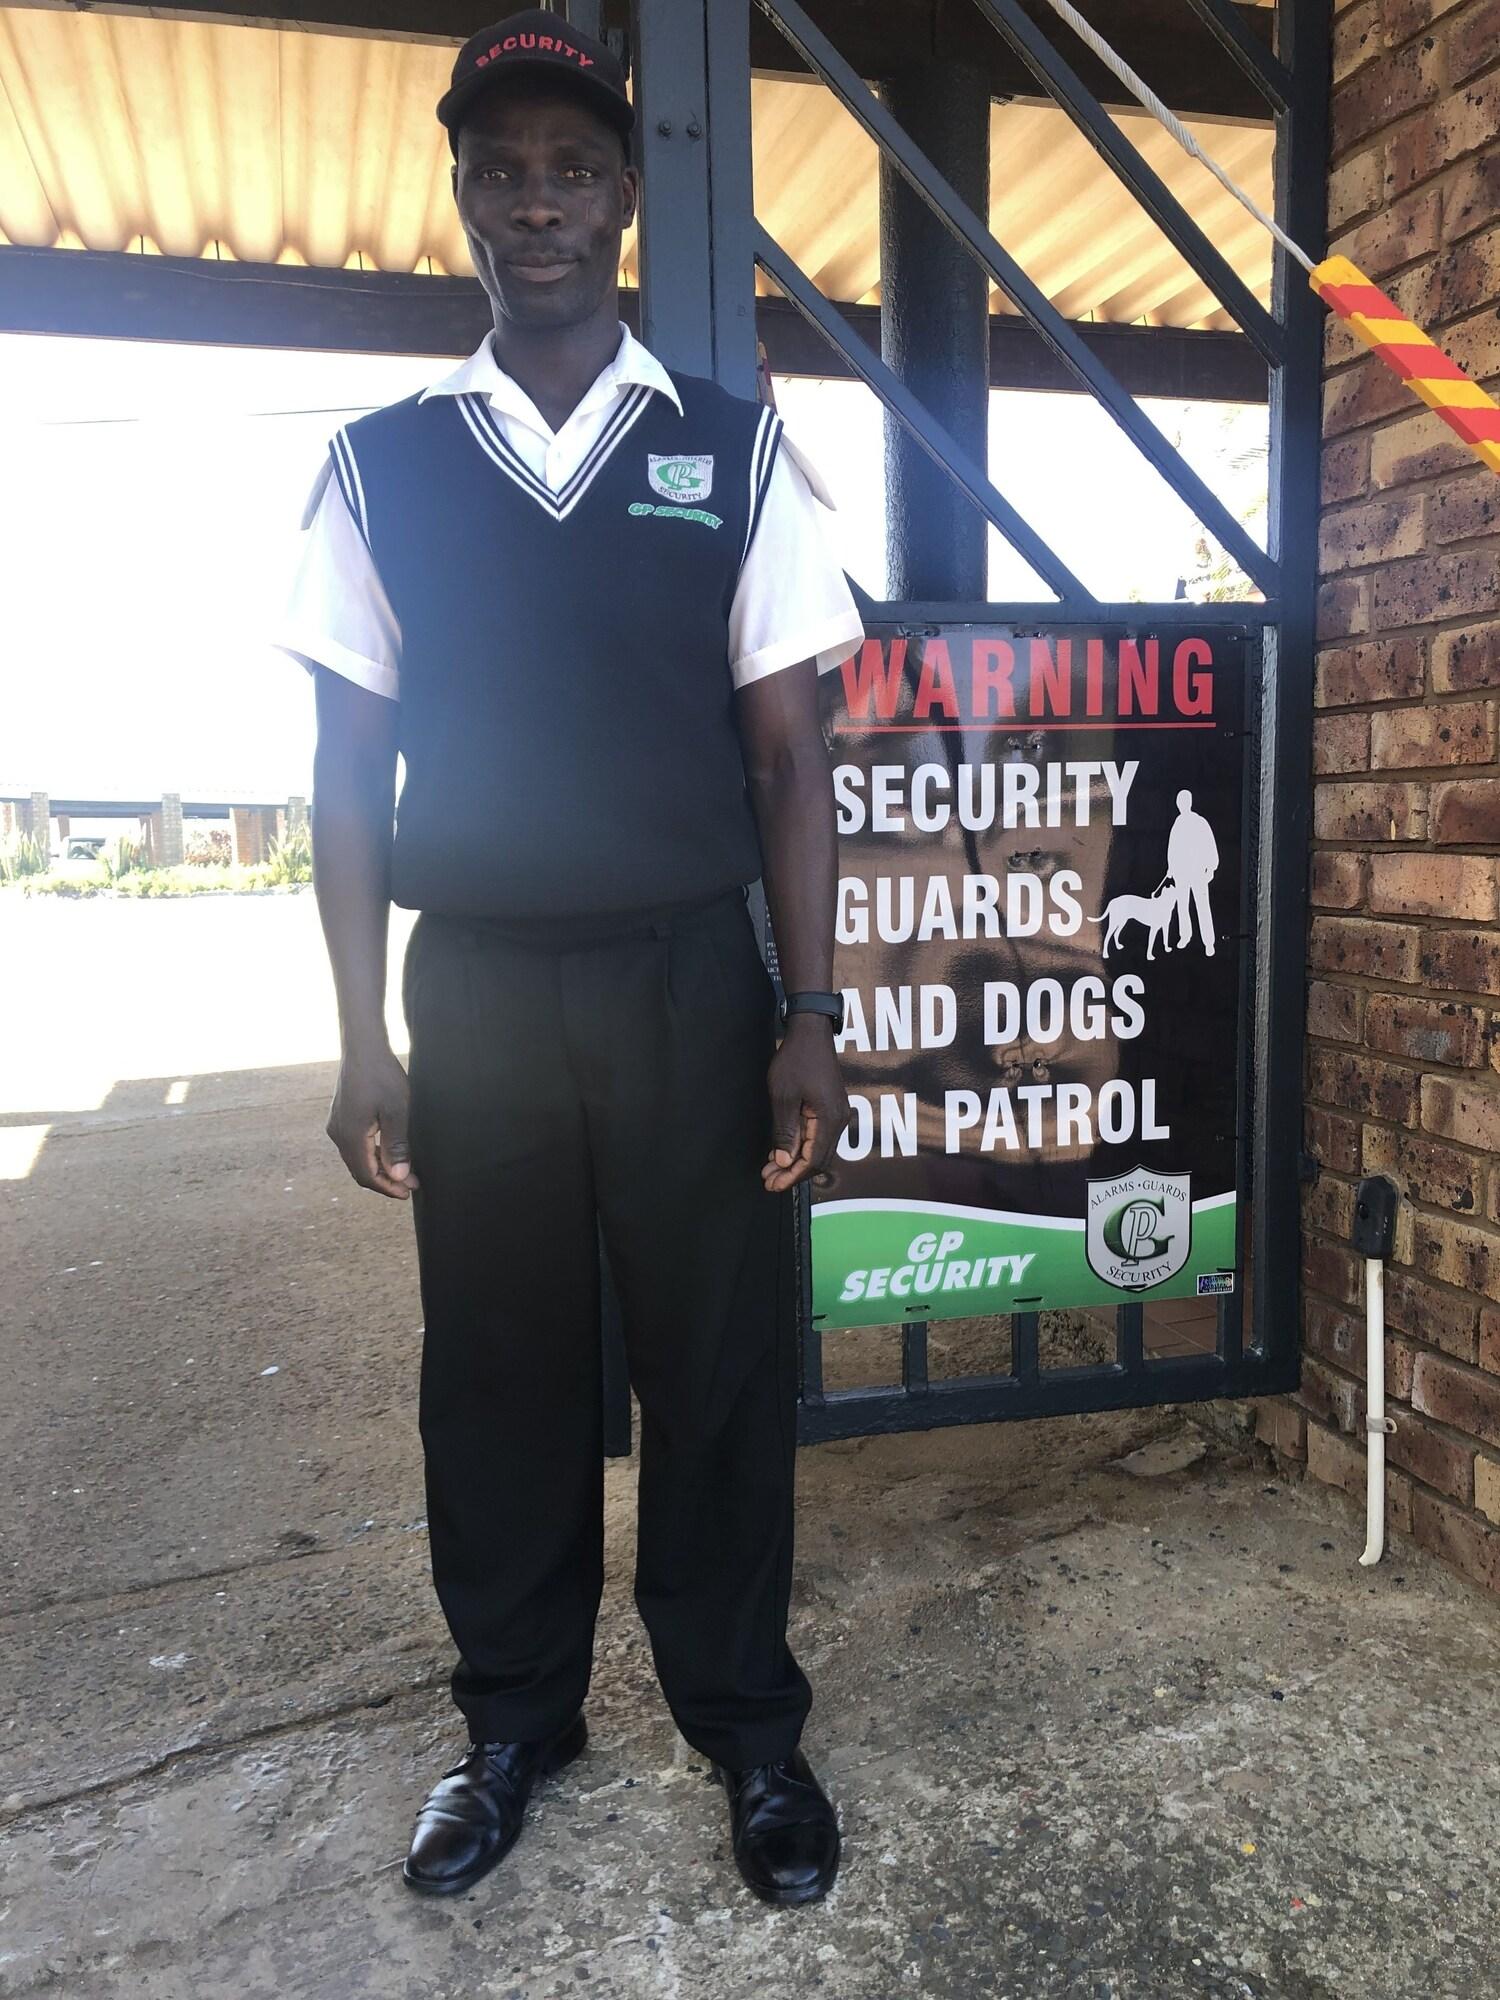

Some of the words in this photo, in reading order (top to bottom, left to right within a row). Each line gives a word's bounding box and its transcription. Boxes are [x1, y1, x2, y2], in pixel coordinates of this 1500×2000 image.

[475, 33, 595, 68] SECURITY
[628, 502, 655, 516] GP
[653, 505, 724, 530] SECURITY
[840, 637, 1214, 719] WARNING
[832, 760, 1140, 835] SECURITY
[834, 869, 1083, 945] GUARDS
[834, 984, 958, 1054] AND
[983, 973, 1146, 1047] DOGS
[836, 1092, 918, 1162] ON
[944, 1078, 1170, 1155] PATROL
[1090, 1180, 1135, 1210] ALARMS
[1142, 1179, 1187, 1202] GUARDS
[838, 1252, 1037, 1302] SECURITY
[907, 1230, 964, 1264] GP
[1106, 1261, 1172, 1283] SECURITY
